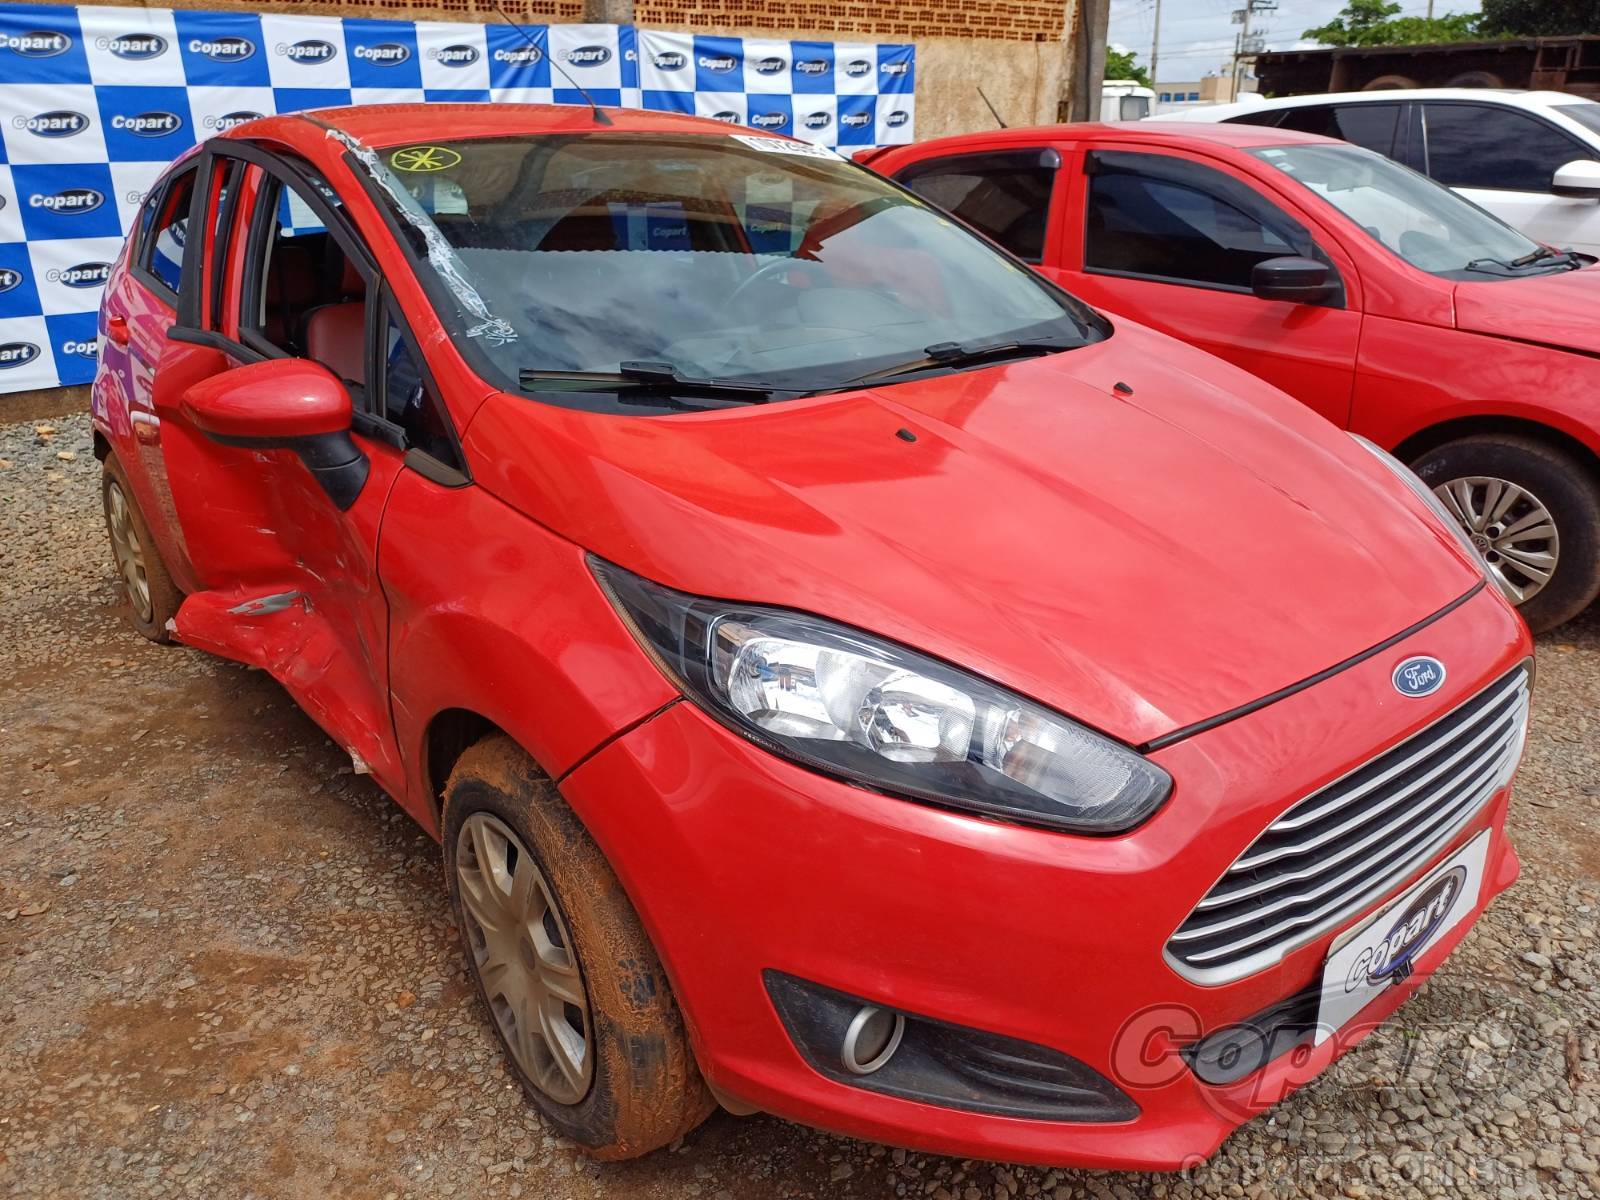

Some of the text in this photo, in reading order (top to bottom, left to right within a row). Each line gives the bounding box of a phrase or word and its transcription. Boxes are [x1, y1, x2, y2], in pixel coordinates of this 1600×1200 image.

[0, 33, 62, 51] Copart
[95, 35, 158, 53] Copart
[188, 39, 248, 57] Copart
[275, 42, 329, 59] Copart
[354, 45, 403, 61] Copart
[428, 47, 473, 62] Copart
[494, 49, 537, 63] Copart
[557, 48, 605, 61] Copart
[699, 56, 734, 70] Copart
[796, 61, 827, 73] Copart
[12, 115, 79, 131] Copart
[112, 114, 173, 132] Copart
[751, 114, 784, 126] Copart
[841, 114, 868, 126] Copart
[29, 193, 95, 208] Copart
[46, 267, 109, 283] Copart
[1404, 664, 1437, 690] Ford
[1344, 874, 1457, 993] Copart
